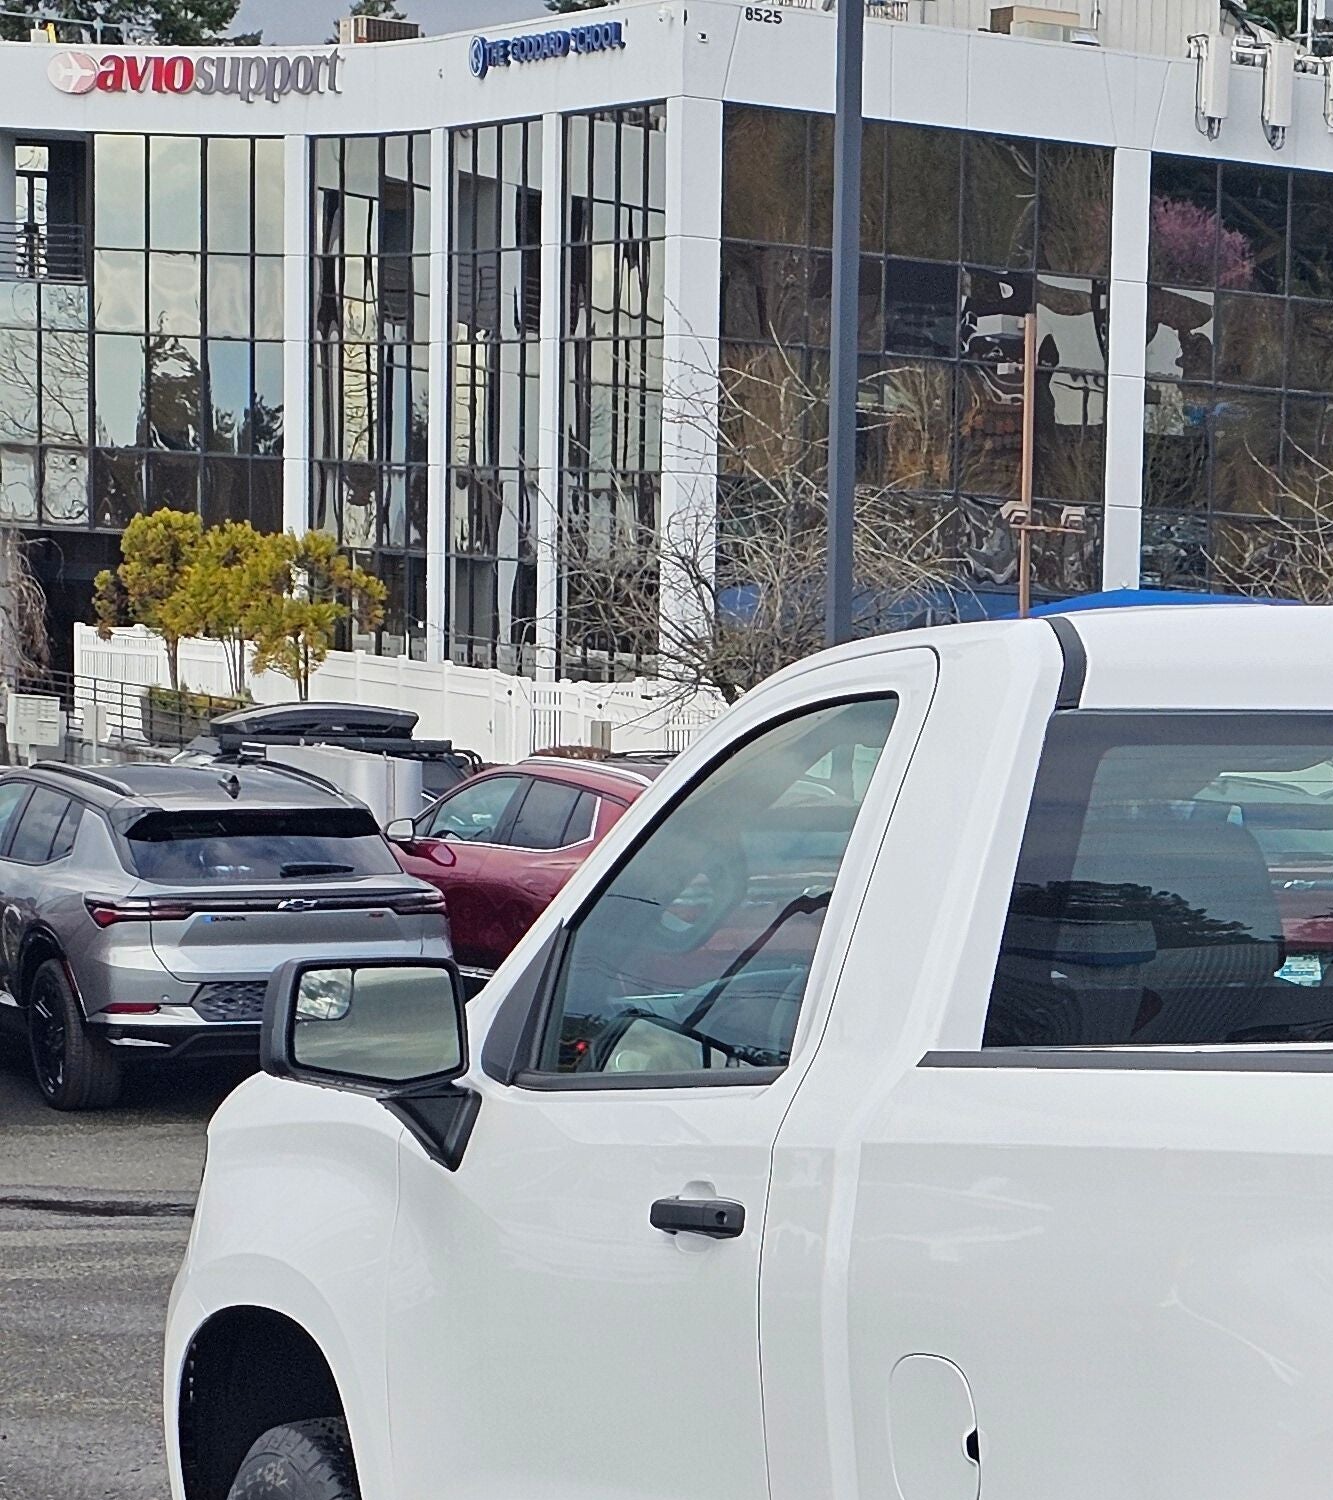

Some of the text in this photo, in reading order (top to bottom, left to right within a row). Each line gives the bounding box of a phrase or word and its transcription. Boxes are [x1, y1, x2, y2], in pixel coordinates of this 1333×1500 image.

[745, 7, 783, 24] 8525
[486, 21, 624, 67] THE GODDARD SCHOOL
